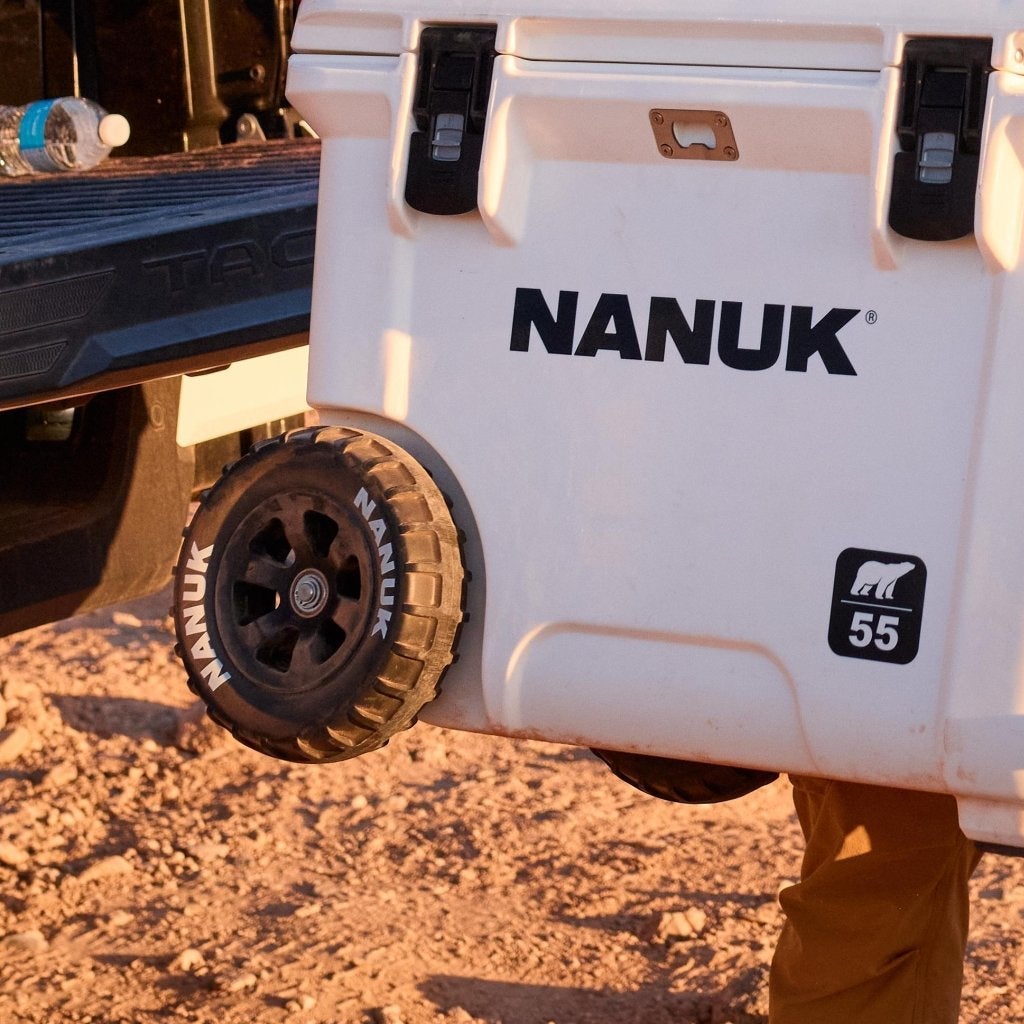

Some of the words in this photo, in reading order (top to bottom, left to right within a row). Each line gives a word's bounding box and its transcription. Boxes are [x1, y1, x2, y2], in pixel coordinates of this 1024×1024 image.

[182, 541, 232, 692] NANUK
[353, 487, 397, 640] NANUK
[848, 611, 900, 652] 55
